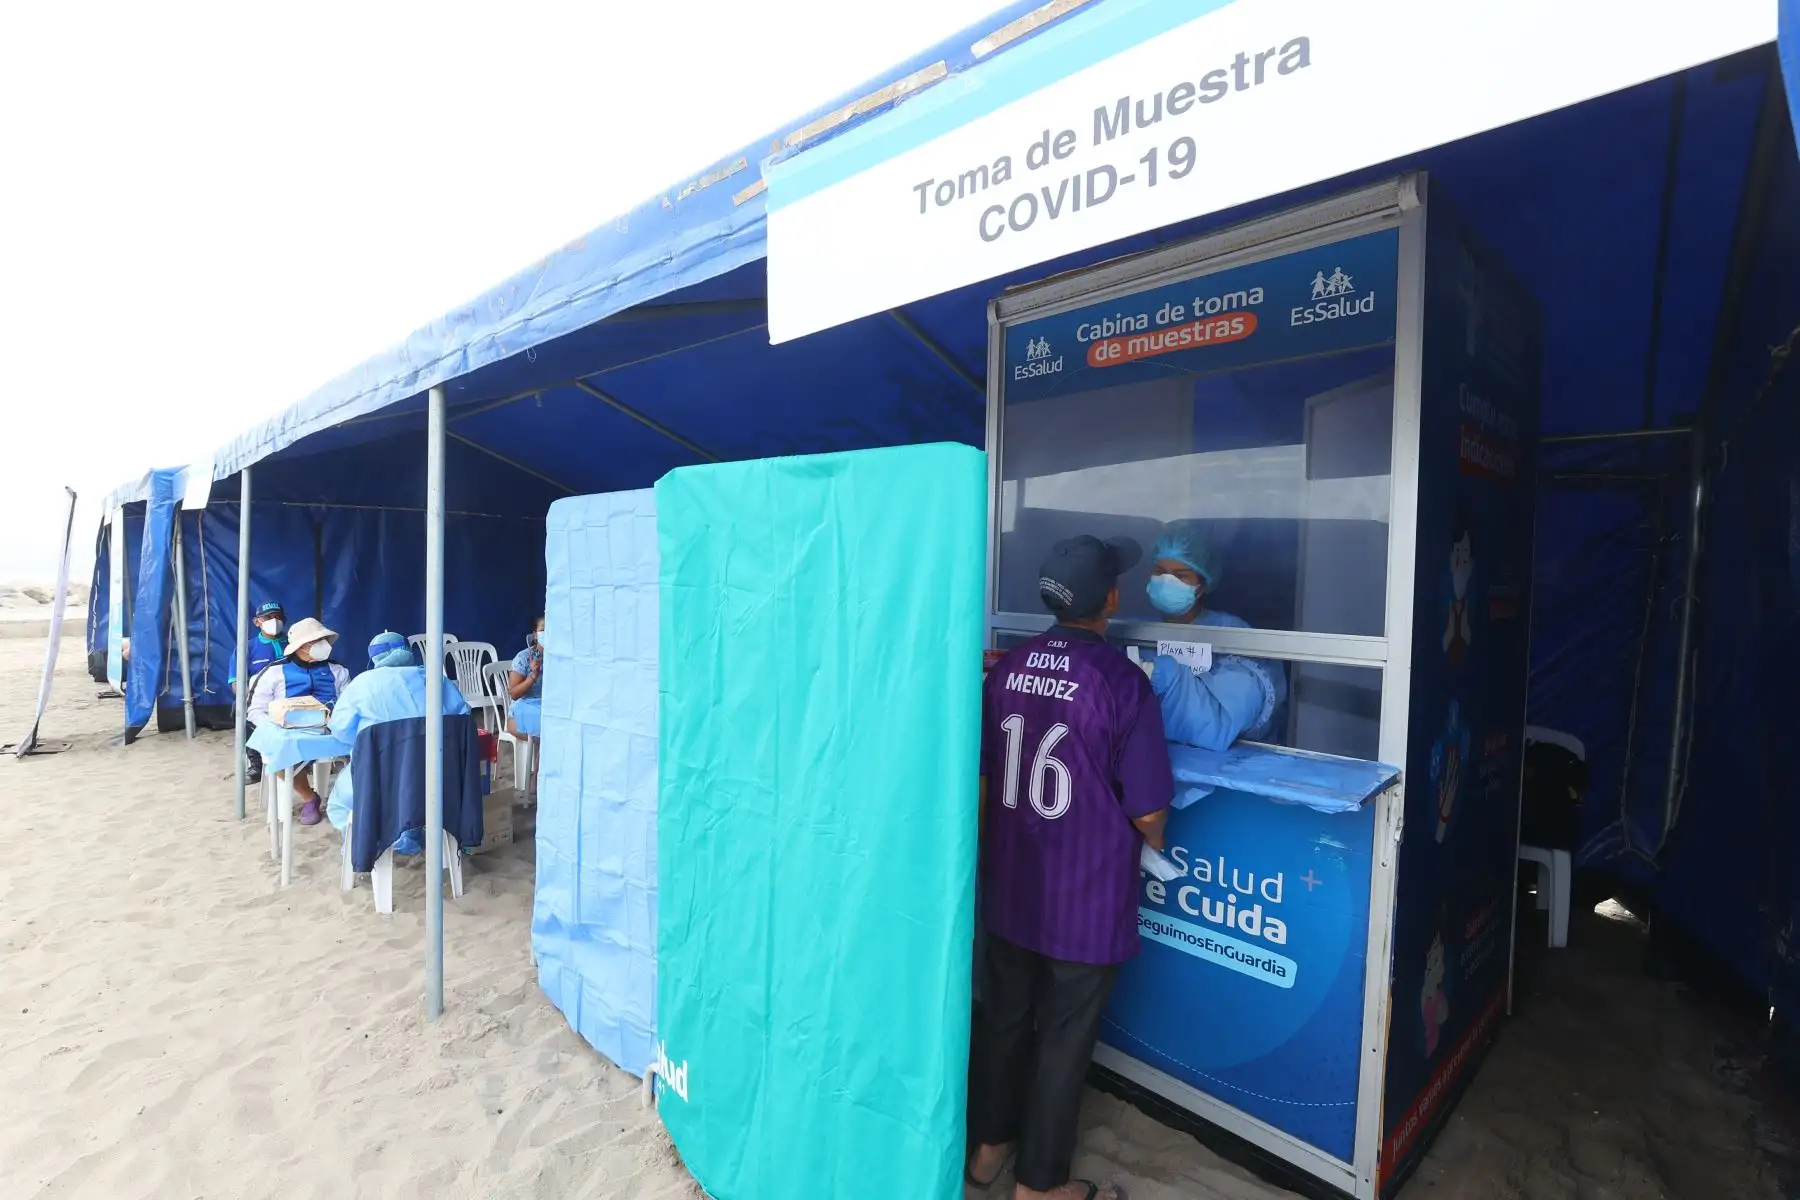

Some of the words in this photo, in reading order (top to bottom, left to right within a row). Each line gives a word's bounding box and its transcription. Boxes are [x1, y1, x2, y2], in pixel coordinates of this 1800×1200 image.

[912, 155, 1013, 215] Toma
[1025, 128, 1077, 172] de
[1092, 34, 1312, 146] Muestra
[979, 136, 1197, 243] COVID-19
[1076, 312, 1149, 343] Cabina
[1155, 302, 1186, 326] de
[1192, 286, 1264, 318] toma
[1290, 292, 1375, 327] EsSalud
[1094, 339, 1122, 362] de
[1127, 316, 1245, 356] muestras
[1014, 355, 1064, 381] EsSalud
[1026, 652, 1070, 672] BBVA
[1047, 640, 1068, 649] CABJ
[1005, 672, 1080, 702] MENDEZ
[1000, 713, 1072, 820] 16
[1161, 845, 1284, 904] Salud
[1177, 885, 1287, 945] Cuida
